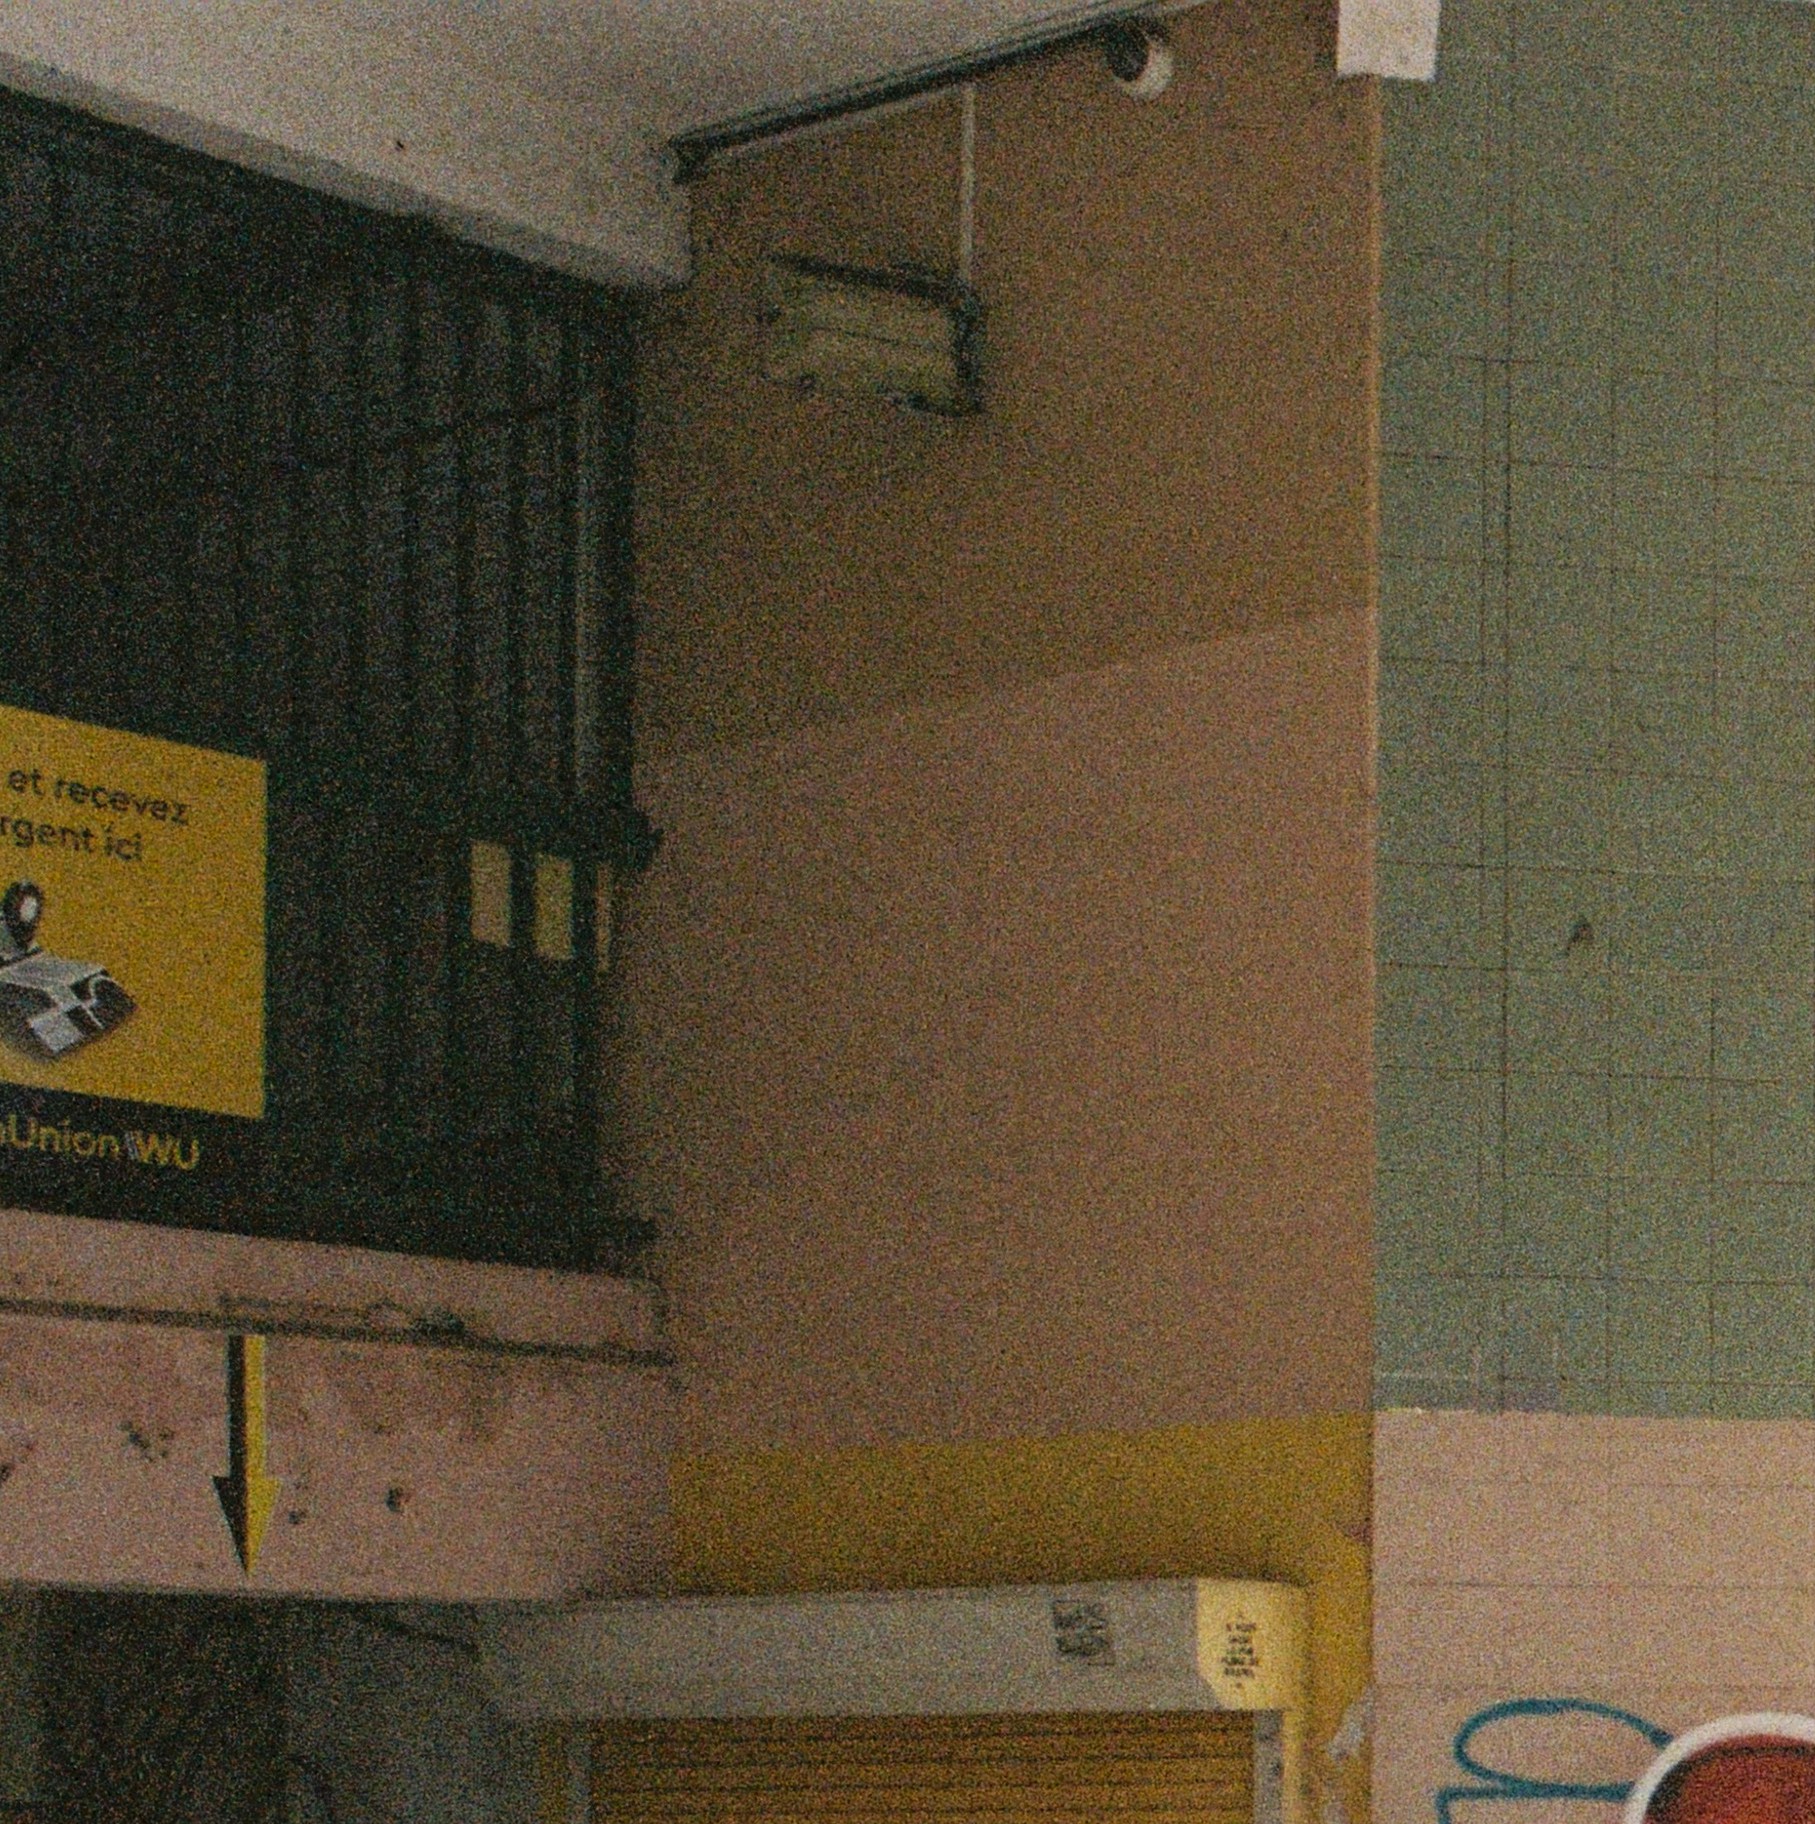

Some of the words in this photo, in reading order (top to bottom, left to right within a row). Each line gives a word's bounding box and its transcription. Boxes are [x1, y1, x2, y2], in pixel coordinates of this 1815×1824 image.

[8, 768, 43, 798] et
[54, 777, 189, 825] recevez
[105, 820, 143, 863] ici
[0, 1112, 120, 1162] Union
